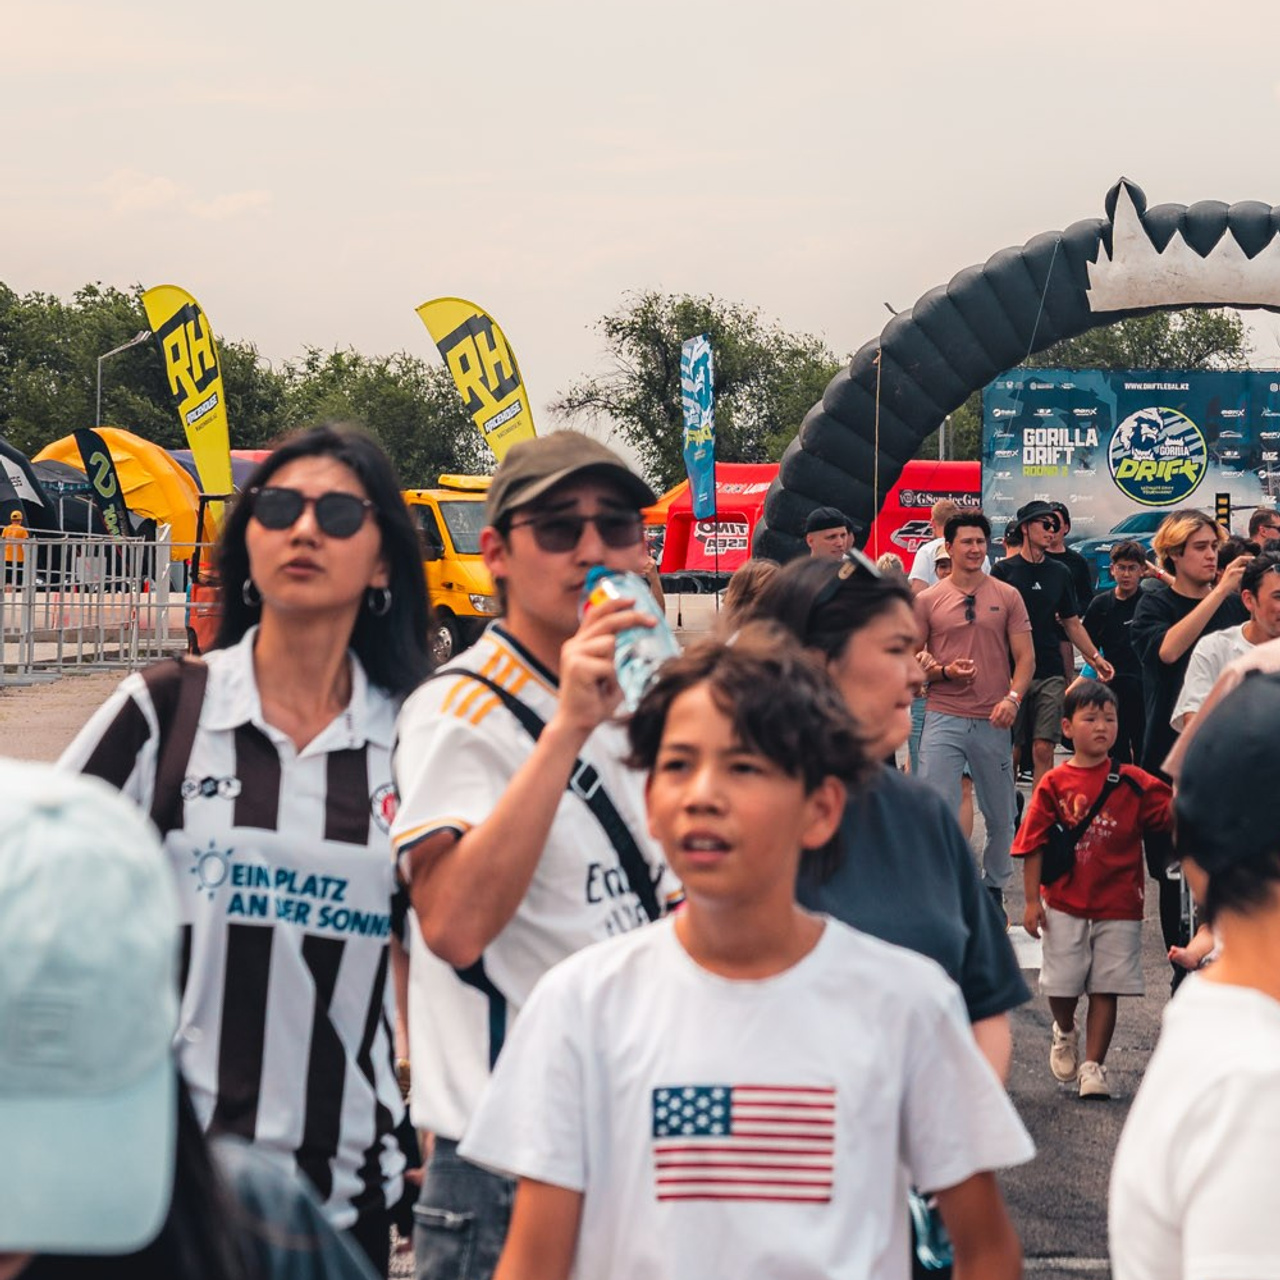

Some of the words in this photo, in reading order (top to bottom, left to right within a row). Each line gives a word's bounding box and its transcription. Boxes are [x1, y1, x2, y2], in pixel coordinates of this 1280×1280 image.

[1023, 428, 1098, 446] GORILLA
[1023, 447, 1075, 465] DRIFT
[1160, 446, 1190, 456] GORILLA
[1115, 458, 1199, 483] DRIFT
[231, 864, 269, 888] EIN
[275, 869, 348, 902] PLATZ
[227, 893, 267, 918] AN
